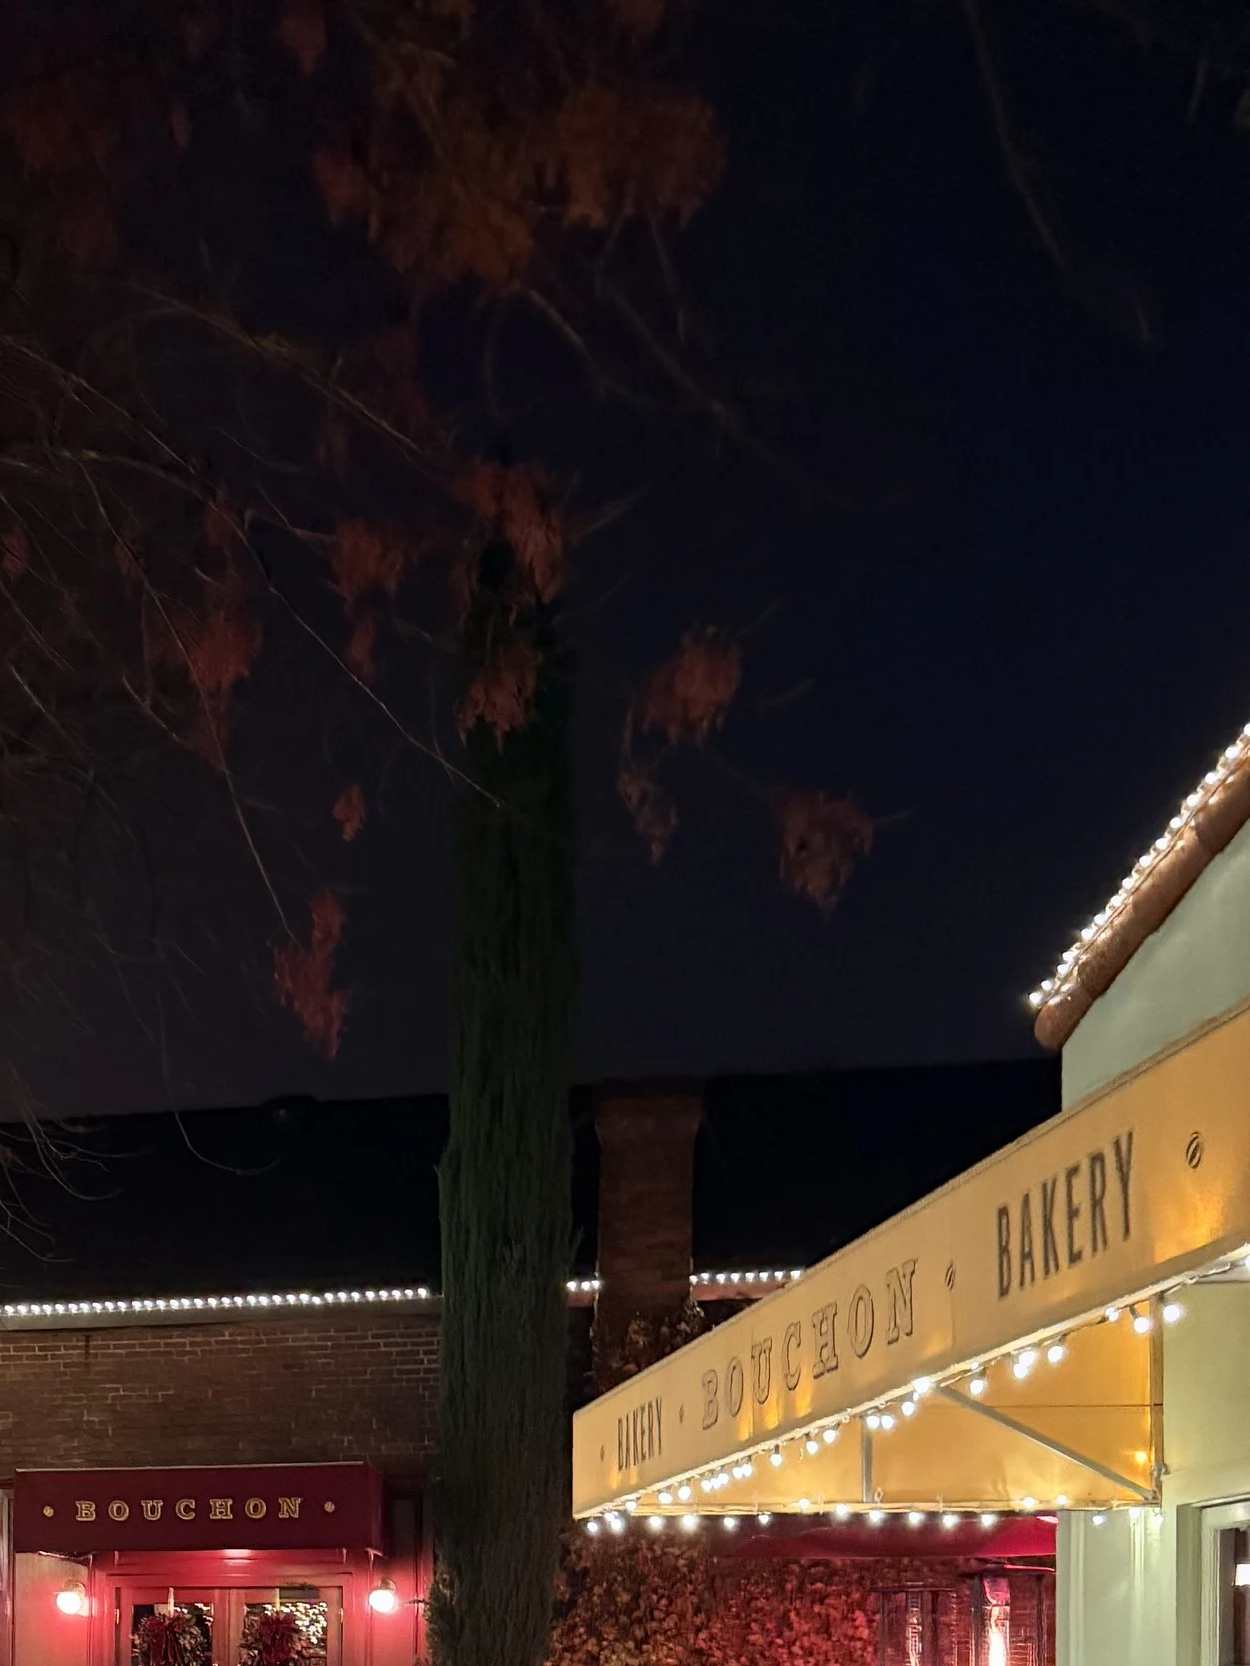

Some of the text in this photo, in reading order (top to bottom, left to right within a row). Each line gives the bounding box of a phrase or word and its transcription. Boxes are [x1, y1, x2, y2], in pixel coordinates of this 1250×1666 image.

[617, 1129, 1134, 1471] BAKERY BOUCHON BAKERY
[76, 1498, 301, 1521] BOUCHON
